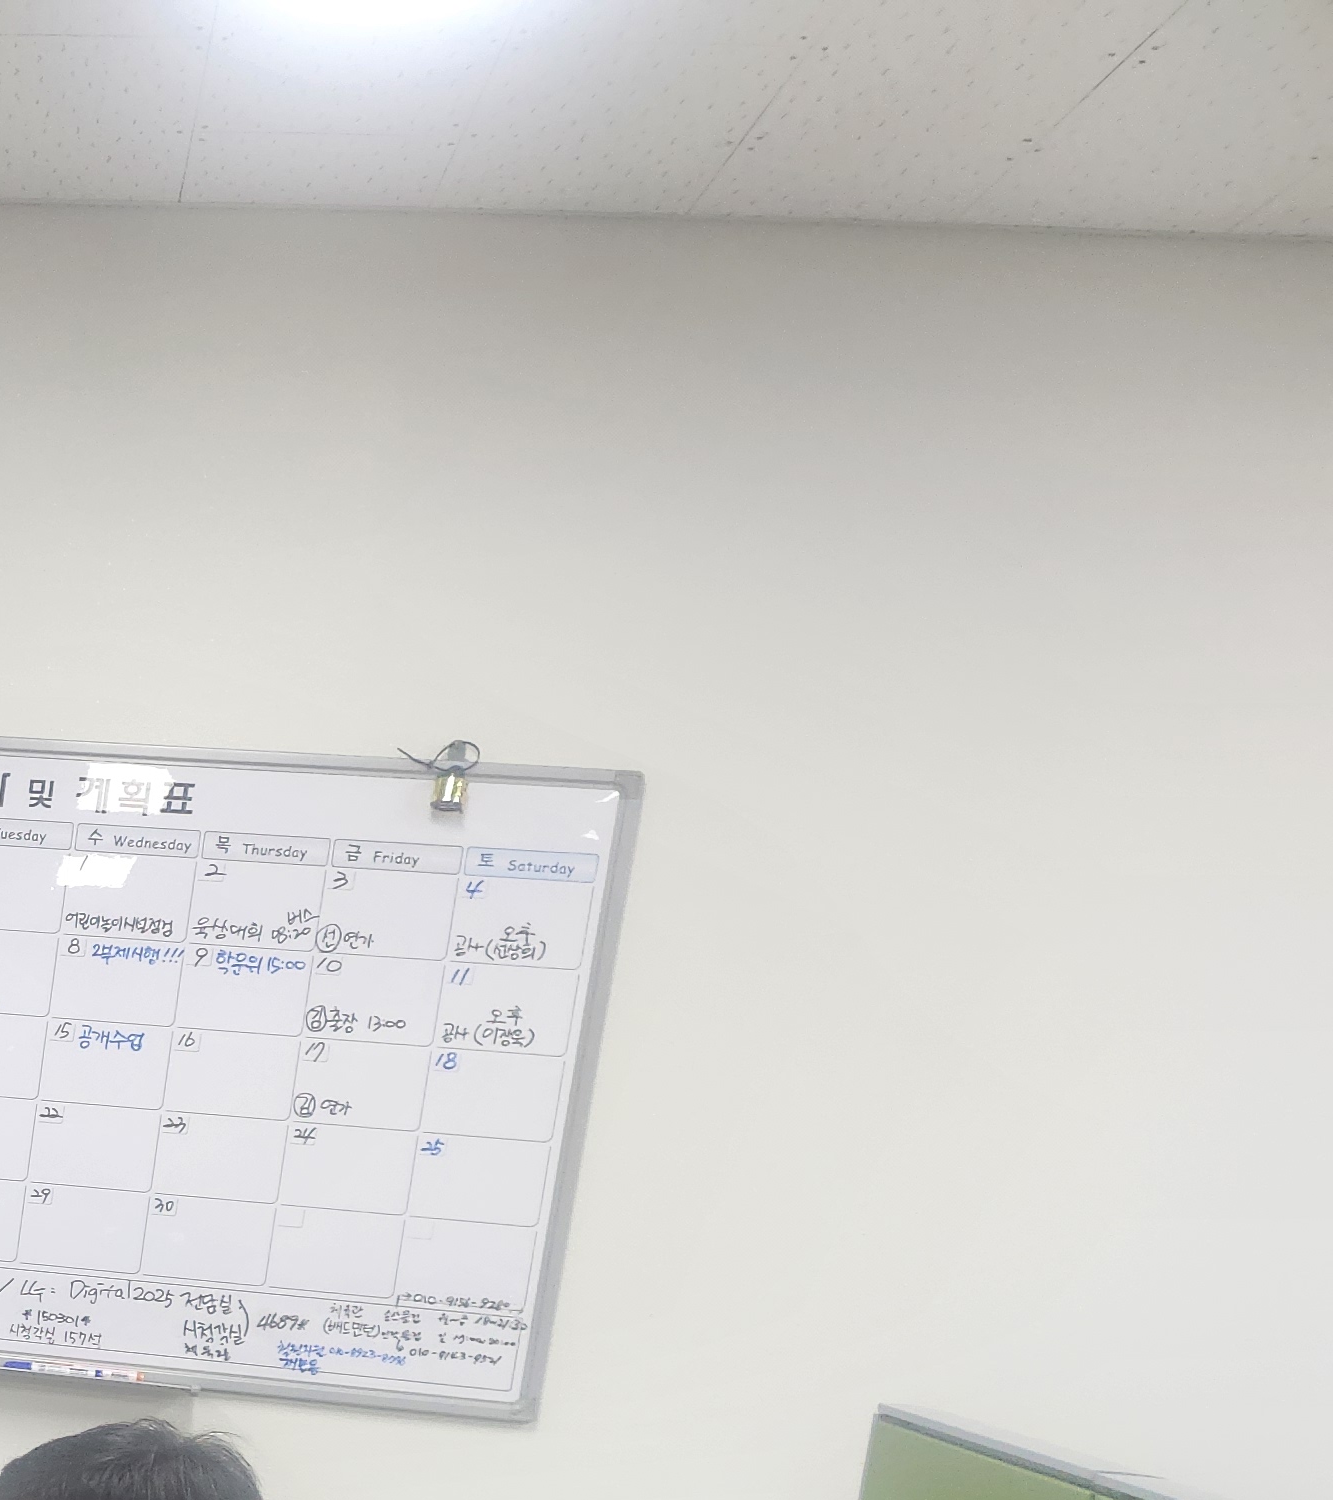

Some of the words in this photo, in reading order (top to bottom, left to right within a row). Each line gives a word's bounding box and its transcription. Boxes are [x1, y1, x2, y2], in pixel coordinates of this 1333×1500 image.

[28, 780, 55, 808] 및
[76, 776, 196, 816] 계획표
[88, 828, 104, 845] 수
[113, 835, 193, 853] Wednesday
[215, 836, 232, 854] 목
[243, 843, 308, 861] Thursday
[345, 844, 362, 862] 금
[373, 852, 420, 868] Friday
[477, 853, 495, 867] 토
[507, 861, 576, 878] Saturday
[204, 864, 227, 877] 2
[333, 871, 349, 890] 3
[465, 880, 484, 899] 4
[287, 908, 320, 926] 버스
[192, 916, 263, 942] 육상대회
[271, 926, 311, 944] 08:20
[343, 930, 374, 949] 연가
[499, 922, 536, 946] 오후
[67, 938, 81, 954] 8
[195, 948, 209, 967] 9
[215, 950, 263, 976] 학운위
[267, 956, 306, 974] 15:00
[317, 957, 343, 972] 10
[451, 968, 470, 986] 11
[326, 1006, 358, 1034] 출장
[367, 1016, 407, 1032] 13:00
[486, 1006, 523, 1026] 오후
[54, 1022, 72, 1040] 15
[79, 1024, 145, 1051] 공개수업
[177, 1032, 195, 1046] 16
[305, 1042, 325, 1062] 17
[435, 1052, 457, 1070] 18
[39, 1106, 63, 1118] 22
[321, 1099, 353, 1115] 연가
[163, 1117, 187, 1134] 23
[293, 1127, 316, 1144] 24
[421, 1138, 445, 1156] 25
[31, 1188, 51, 1204] 29
[154, 1198, 175, 1212] 30
[183, 1320, 245, 1345] 시청각실
